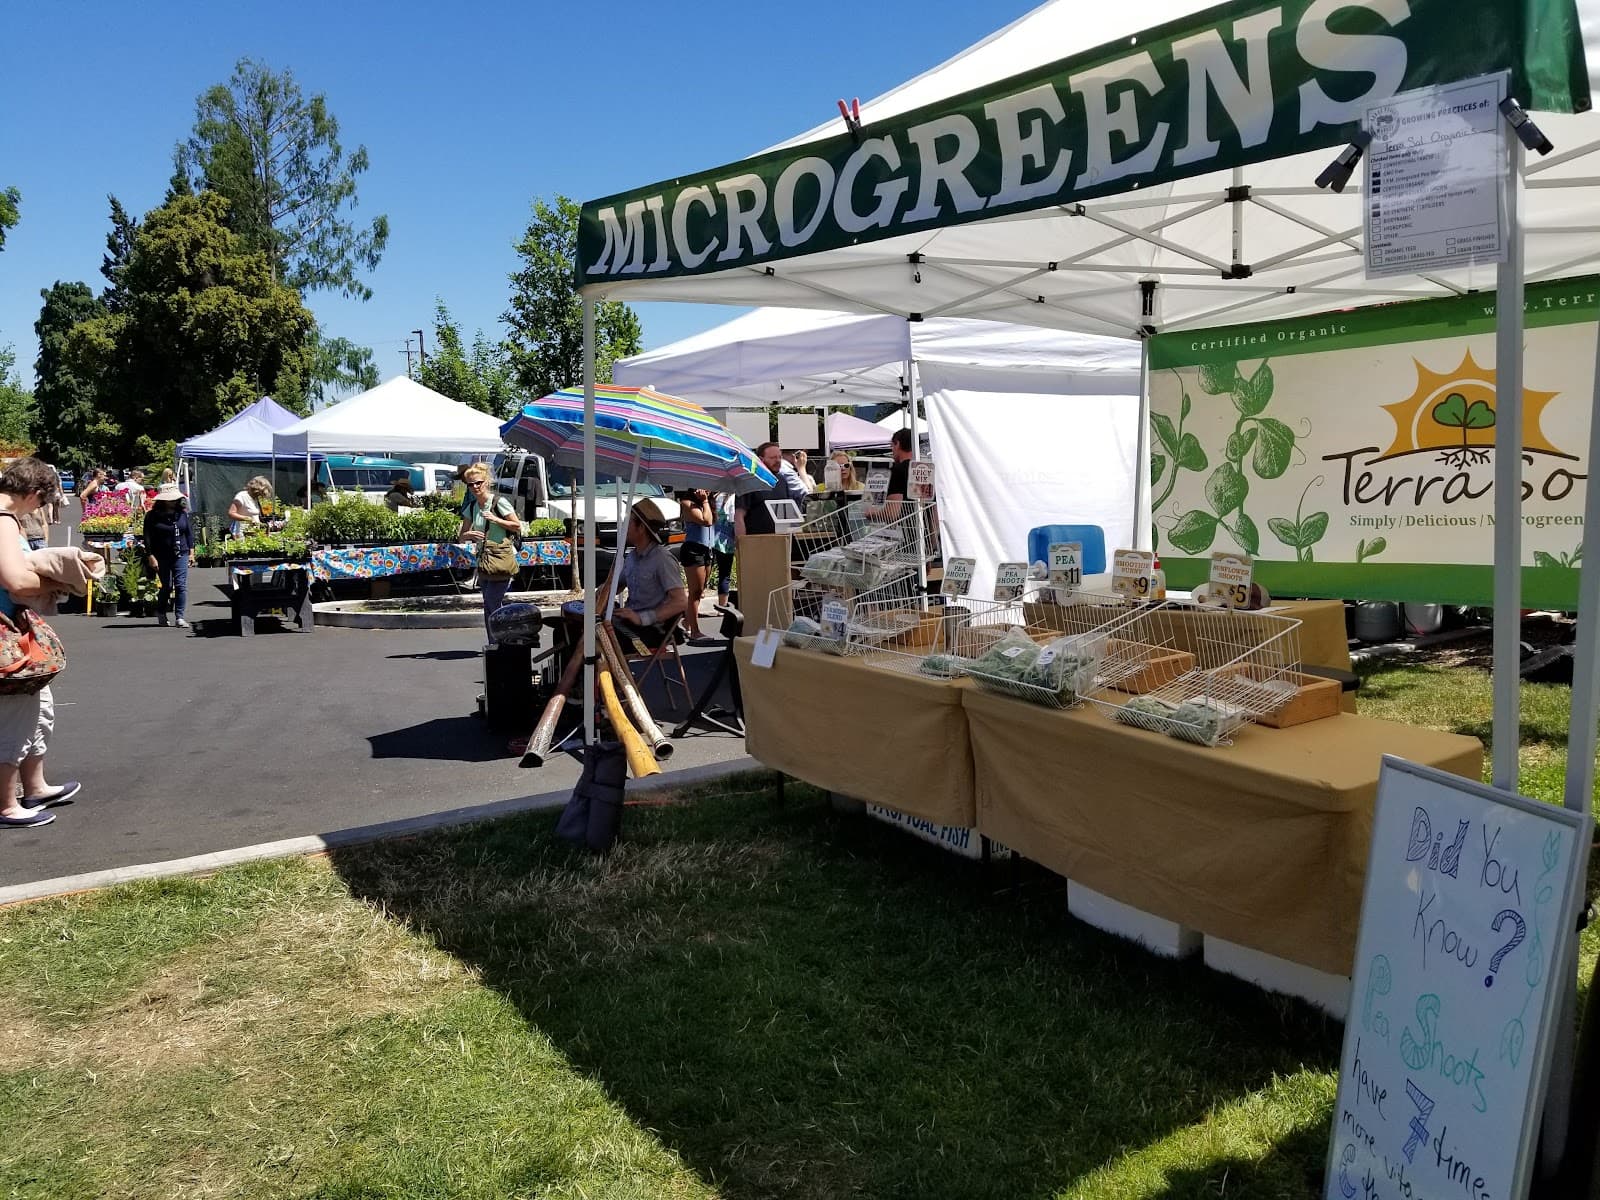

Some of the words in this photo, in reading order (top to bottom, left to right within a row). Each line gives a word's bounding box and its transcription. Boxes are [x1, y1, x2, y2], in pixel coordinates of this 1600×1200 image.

[586, 0, 1412, 275] MICROGREENS
[1191, 333, 1267, 351] Certified
[1277, 325, 1347, 342] Organic
[1322, 446, 1494, 506] Terra
[1350, 514, 1397, 530] Simply
[1406, 513, 1477, 528] Delicious
[953, 564, 967, 573] PEA
[1055, 554, 1076, 565] PEA
[1004, 570, 1018, 578] PEA
[1063, 567, 1080, 585] $11
[1132, 576, 1149, 595] $9
[1228, 584, 1247, 603] $5
[940, 825, 971, 849] FISH
[1406, 806, 1470, 880] Did
[1480, 823, 1522, 906] You
[1361, 954, 1392, 1046] Pea
[1399, 993, 1488, 1113] Shoots
[1352, 1036, 1387, 1121] have
[1402, 1077, 1436, 1165] 7
[1342, 1109, 1376, 1158] more
